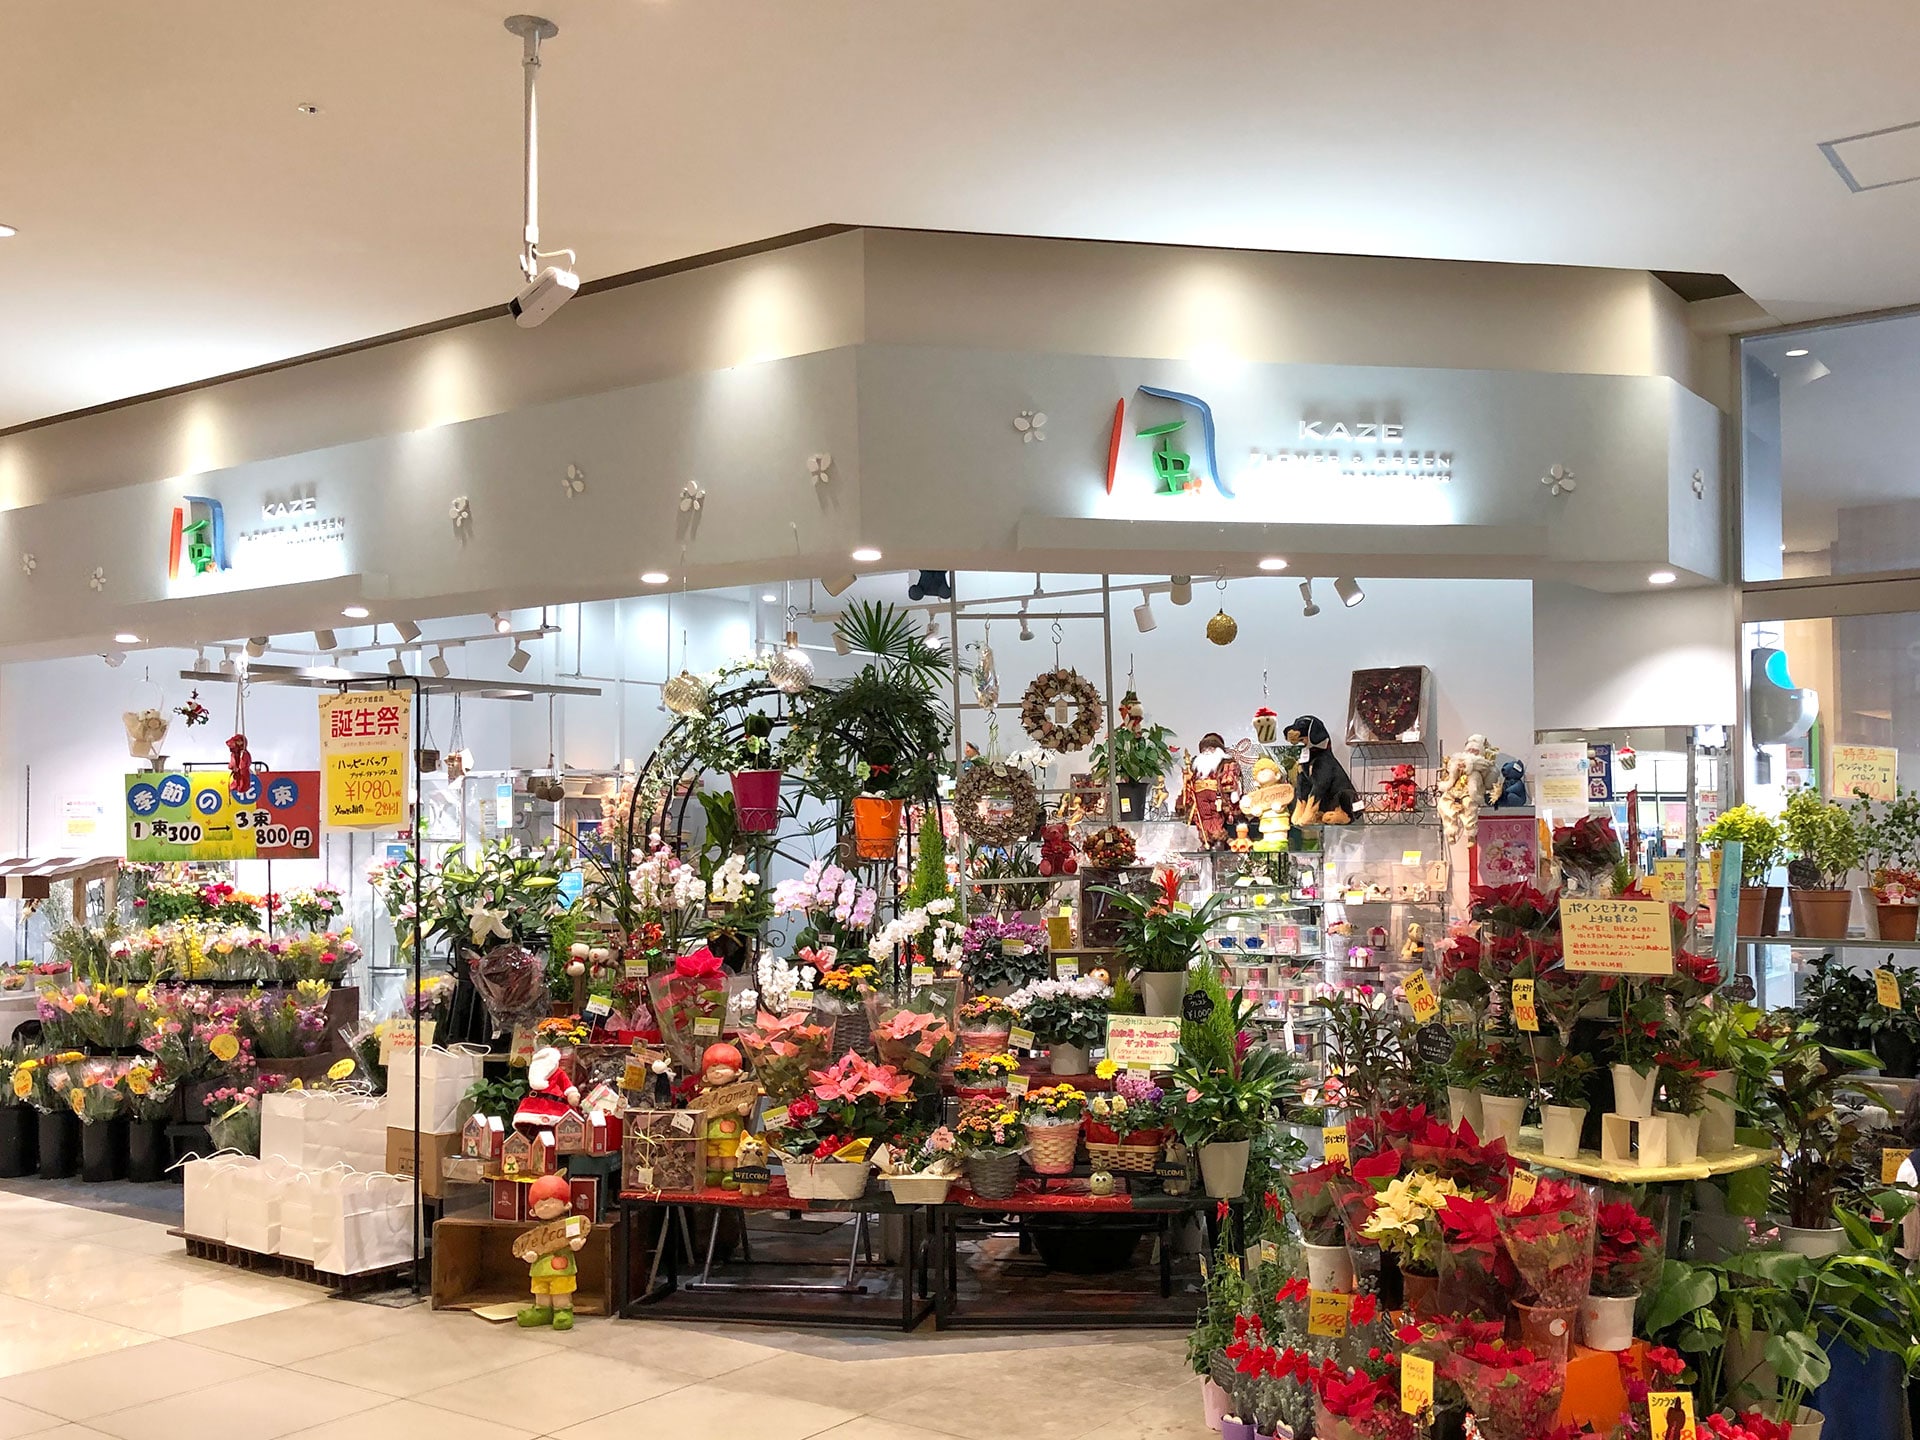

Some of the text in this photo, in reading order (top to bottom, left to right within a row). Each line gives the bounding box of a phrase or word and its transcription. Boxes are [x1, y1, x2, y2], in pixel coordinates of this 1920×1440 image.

[1299, 421, 1405, 443] KAZE
[261, 497, 317, 520] KAZE
[331, 706, 399, 738] 誕生祭
[1843, 748, 1877, 760] 特売品
[345, 780, 392, 802] ¥1980
[1569, 903, 1637, 914] ポインセチアの
[734, 1171, 768, 1180] WELCOME
[1156, 1169, 1185, 1177] WELCOME
[1316, 1297, 1346, 1306] コニファー
